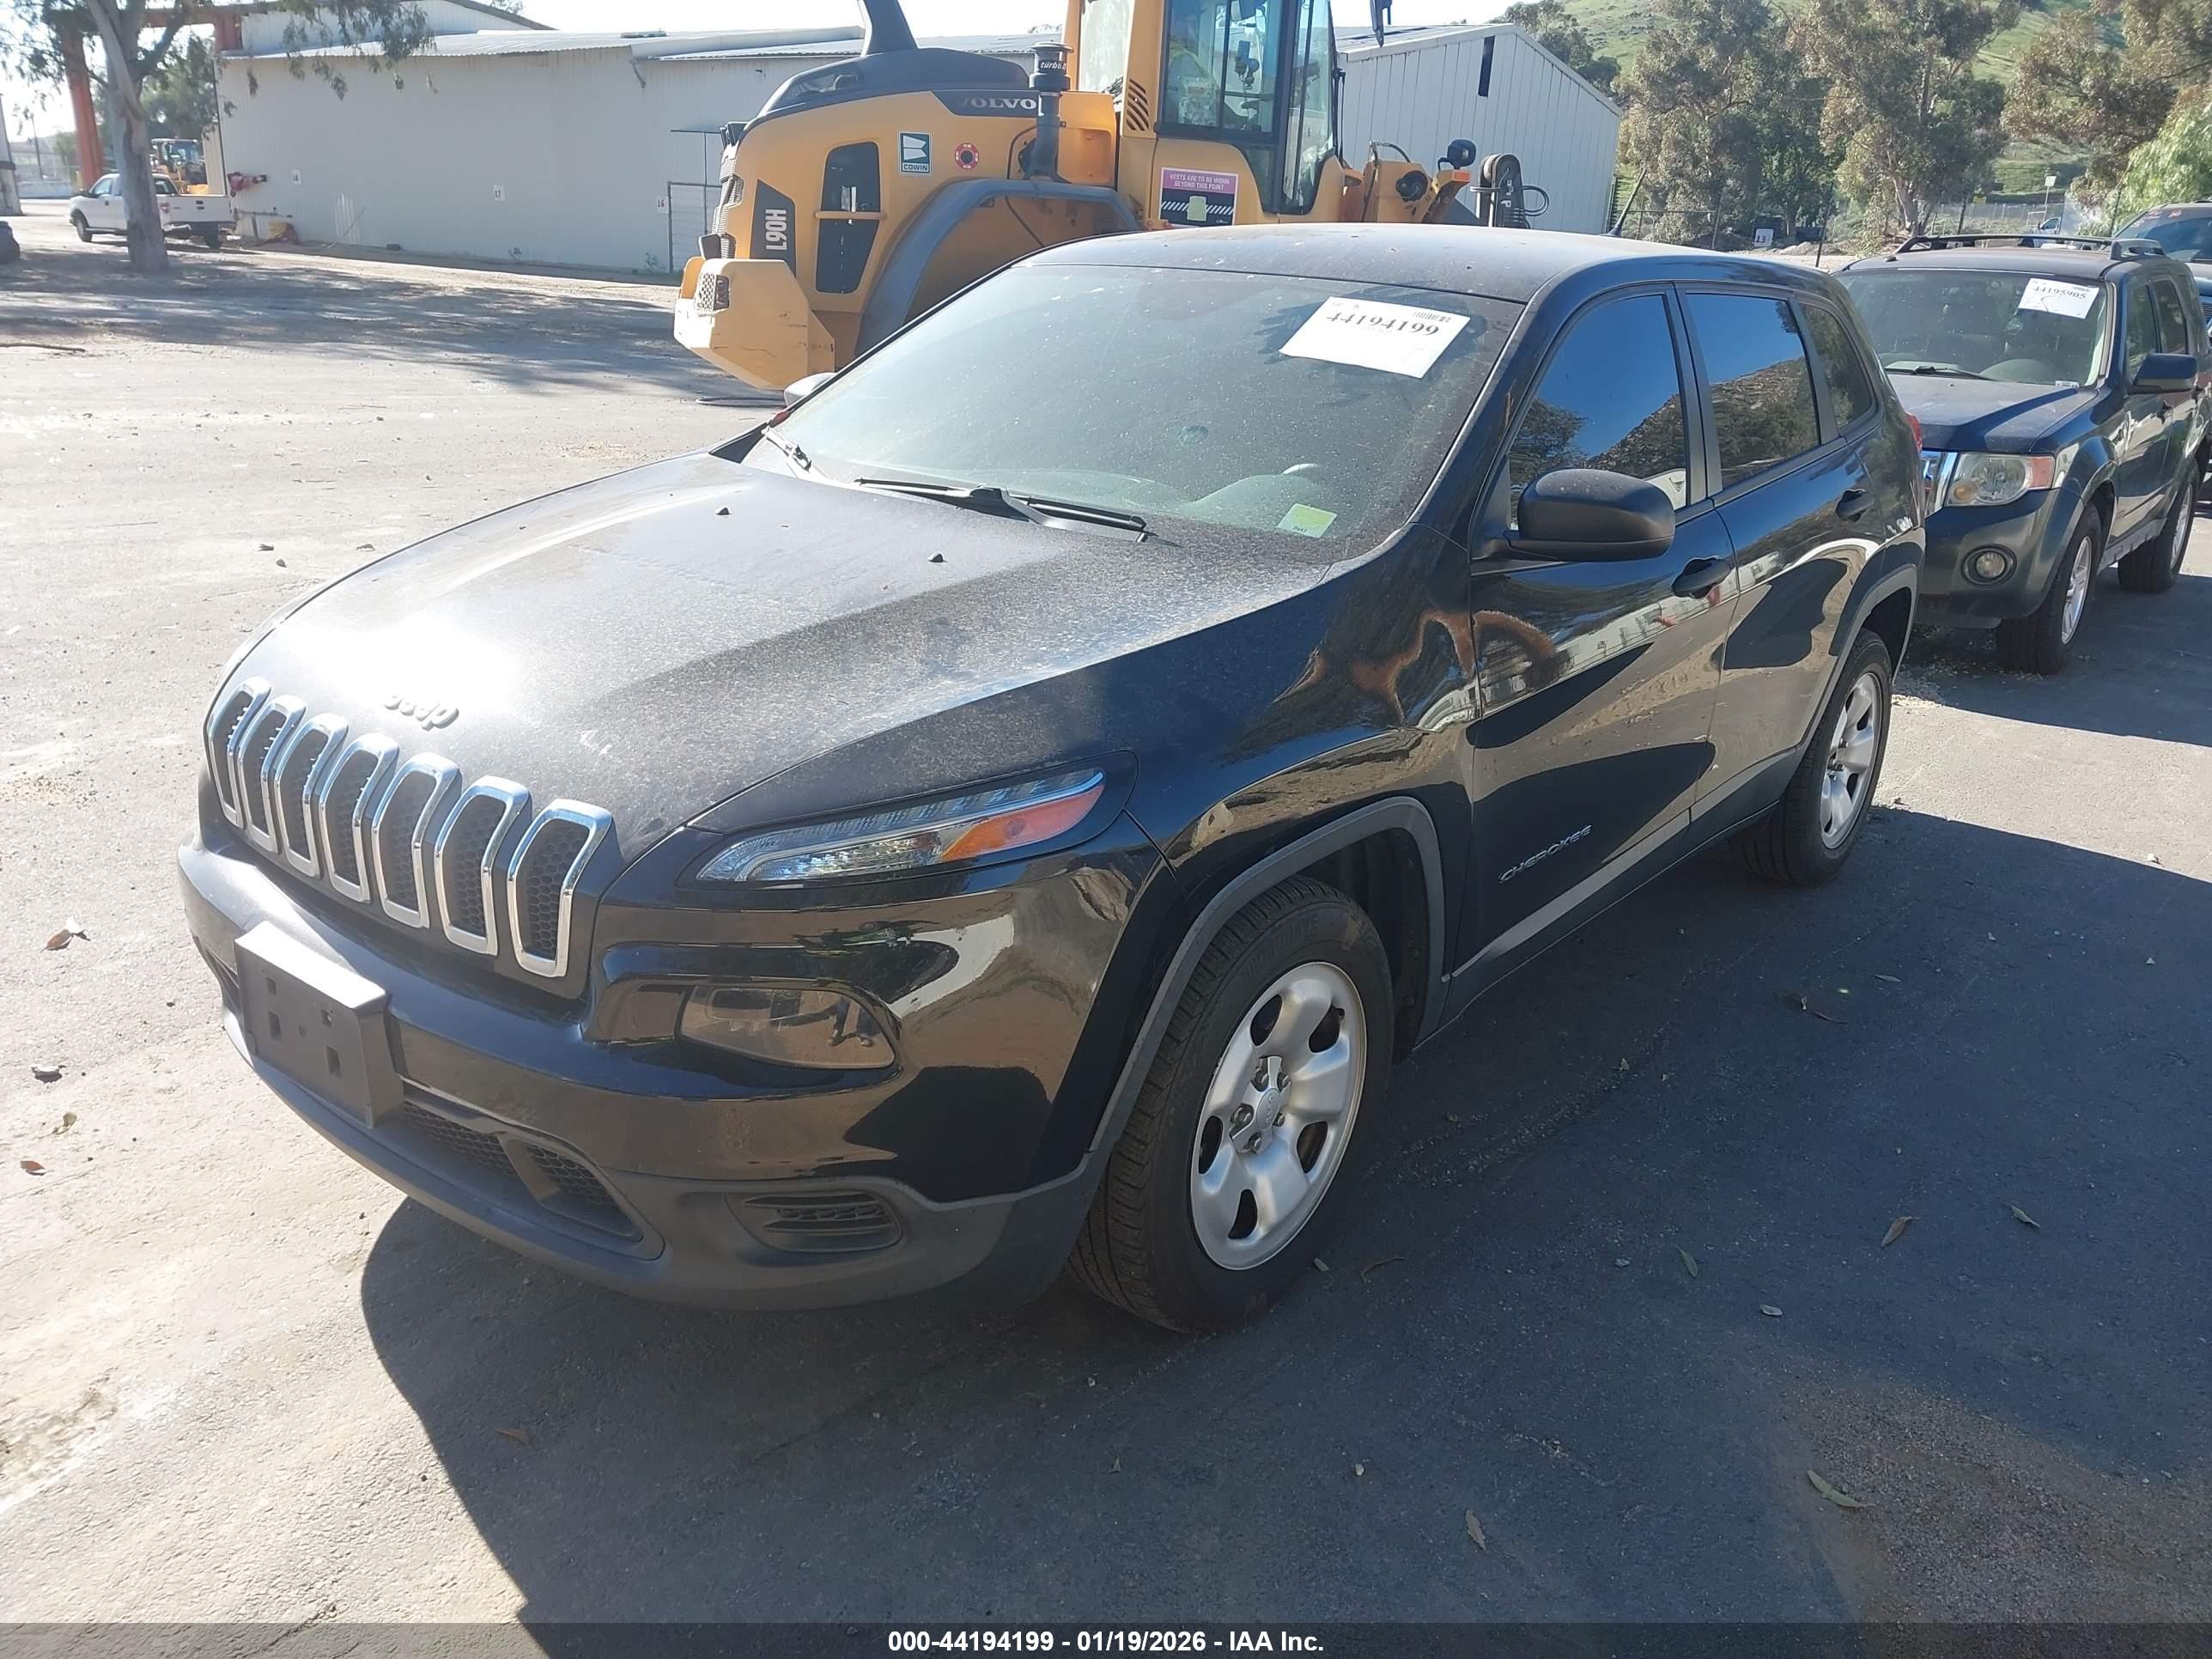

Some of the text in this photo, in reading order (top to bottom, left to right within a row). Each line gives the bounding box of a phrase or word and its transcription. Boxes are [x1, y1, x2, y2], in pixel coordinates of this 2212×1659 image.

[1040, 61, 1062, 70] turbo
[765, 209, 787, 251] L90H
[1326, 312, 1439, 336] 44194199
